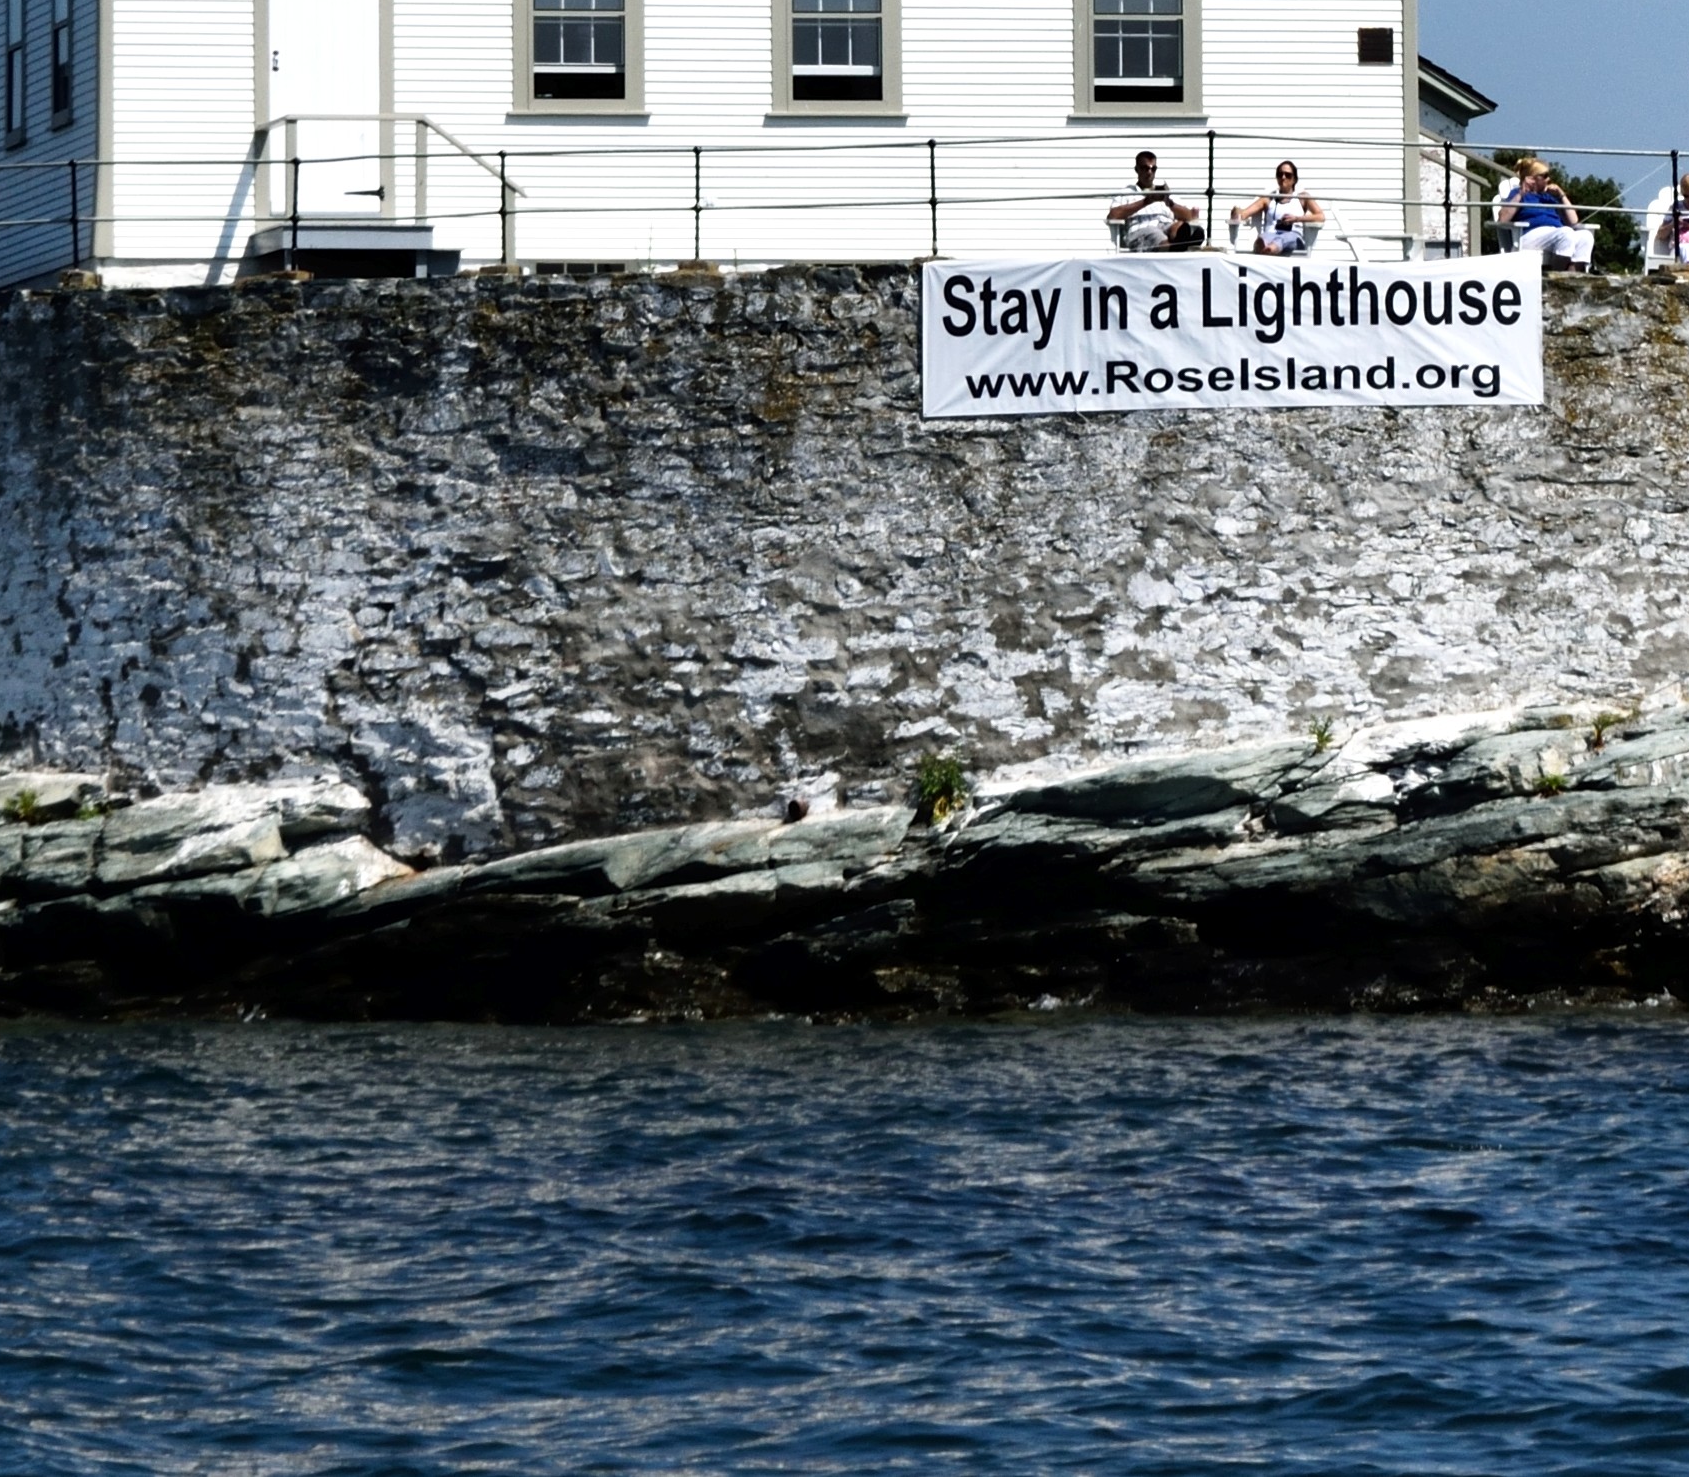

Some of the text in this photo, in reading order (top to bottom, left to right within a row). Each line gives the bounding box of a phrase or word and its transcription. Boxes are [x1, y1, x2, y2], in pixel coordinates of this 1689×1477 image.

[941, 265, 1522, 351] Stay in a Lighthouse
[965, 356, 1501, 399] www.RoseIsland.org
